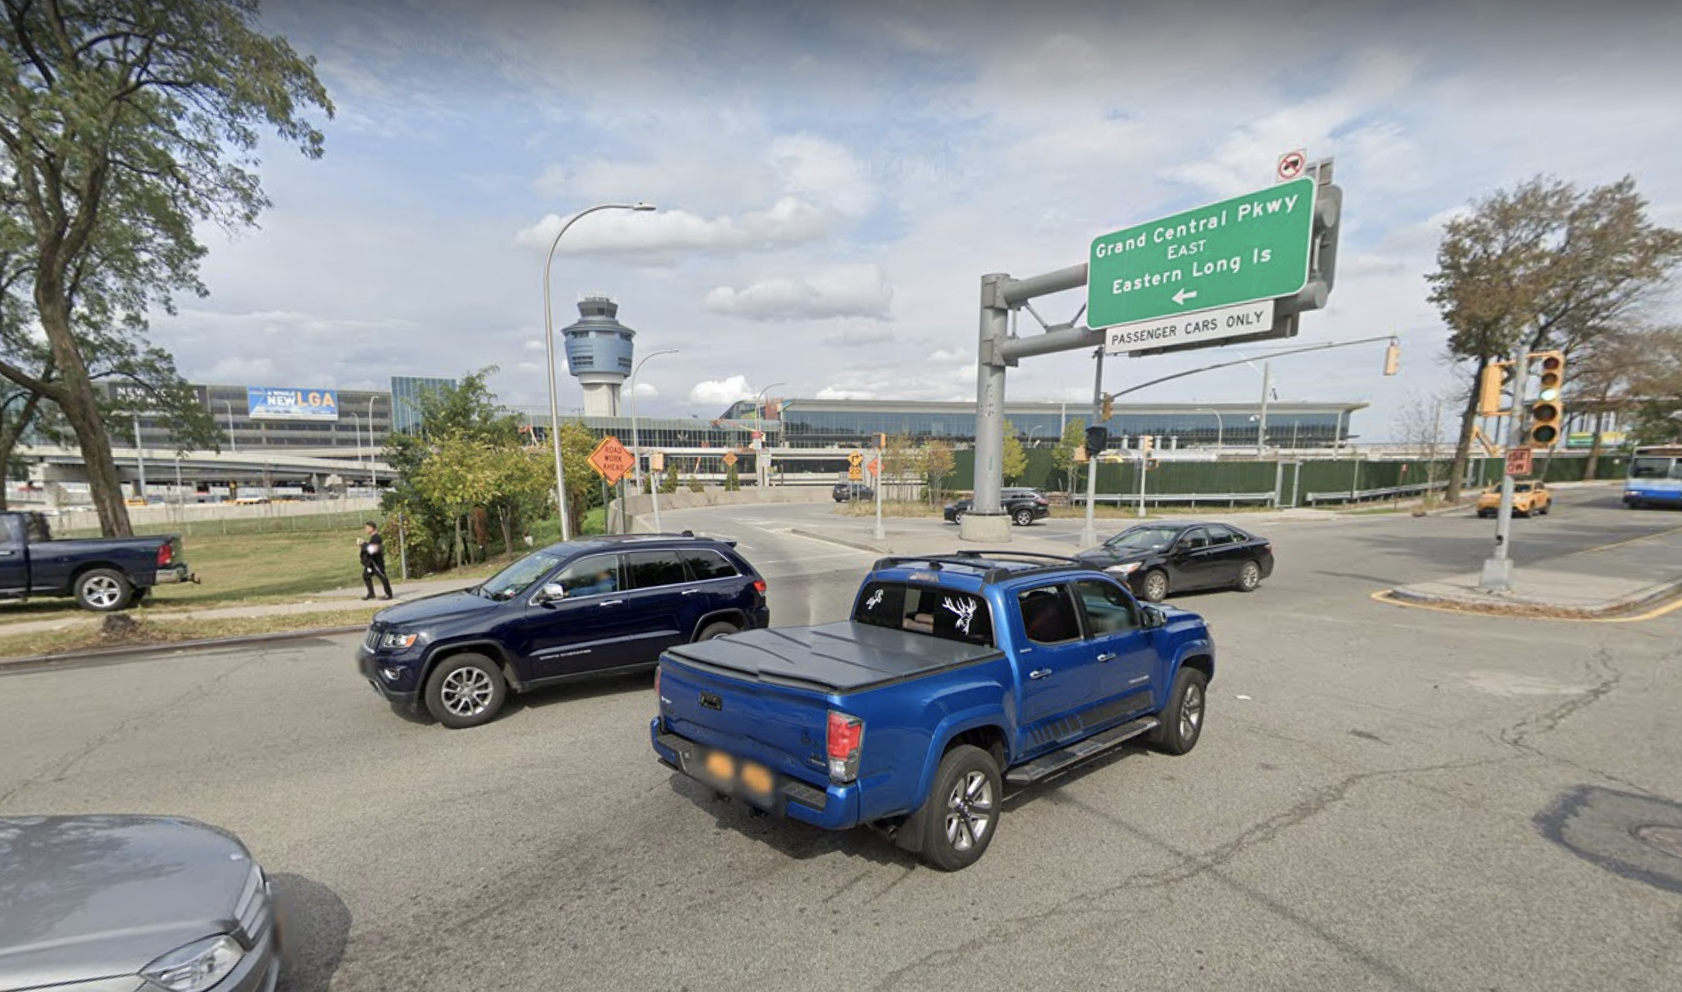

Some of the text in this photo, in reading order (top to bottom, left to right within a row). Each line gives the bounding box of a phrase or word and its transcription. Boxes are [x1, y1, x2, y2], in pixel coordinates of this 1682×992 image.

[1096, 194, 1298, 258] Grand Central Pkwy
[1167, 239, 1207, 260] EAST
[1112, 247, 1272, 294] Eastern Long Is
[1111, 310, 1264, 346] PASSENGER CARS ONLY
[266, 391, 335, 407] NEW LGA
[605, 446, 622, 454] ROAD
